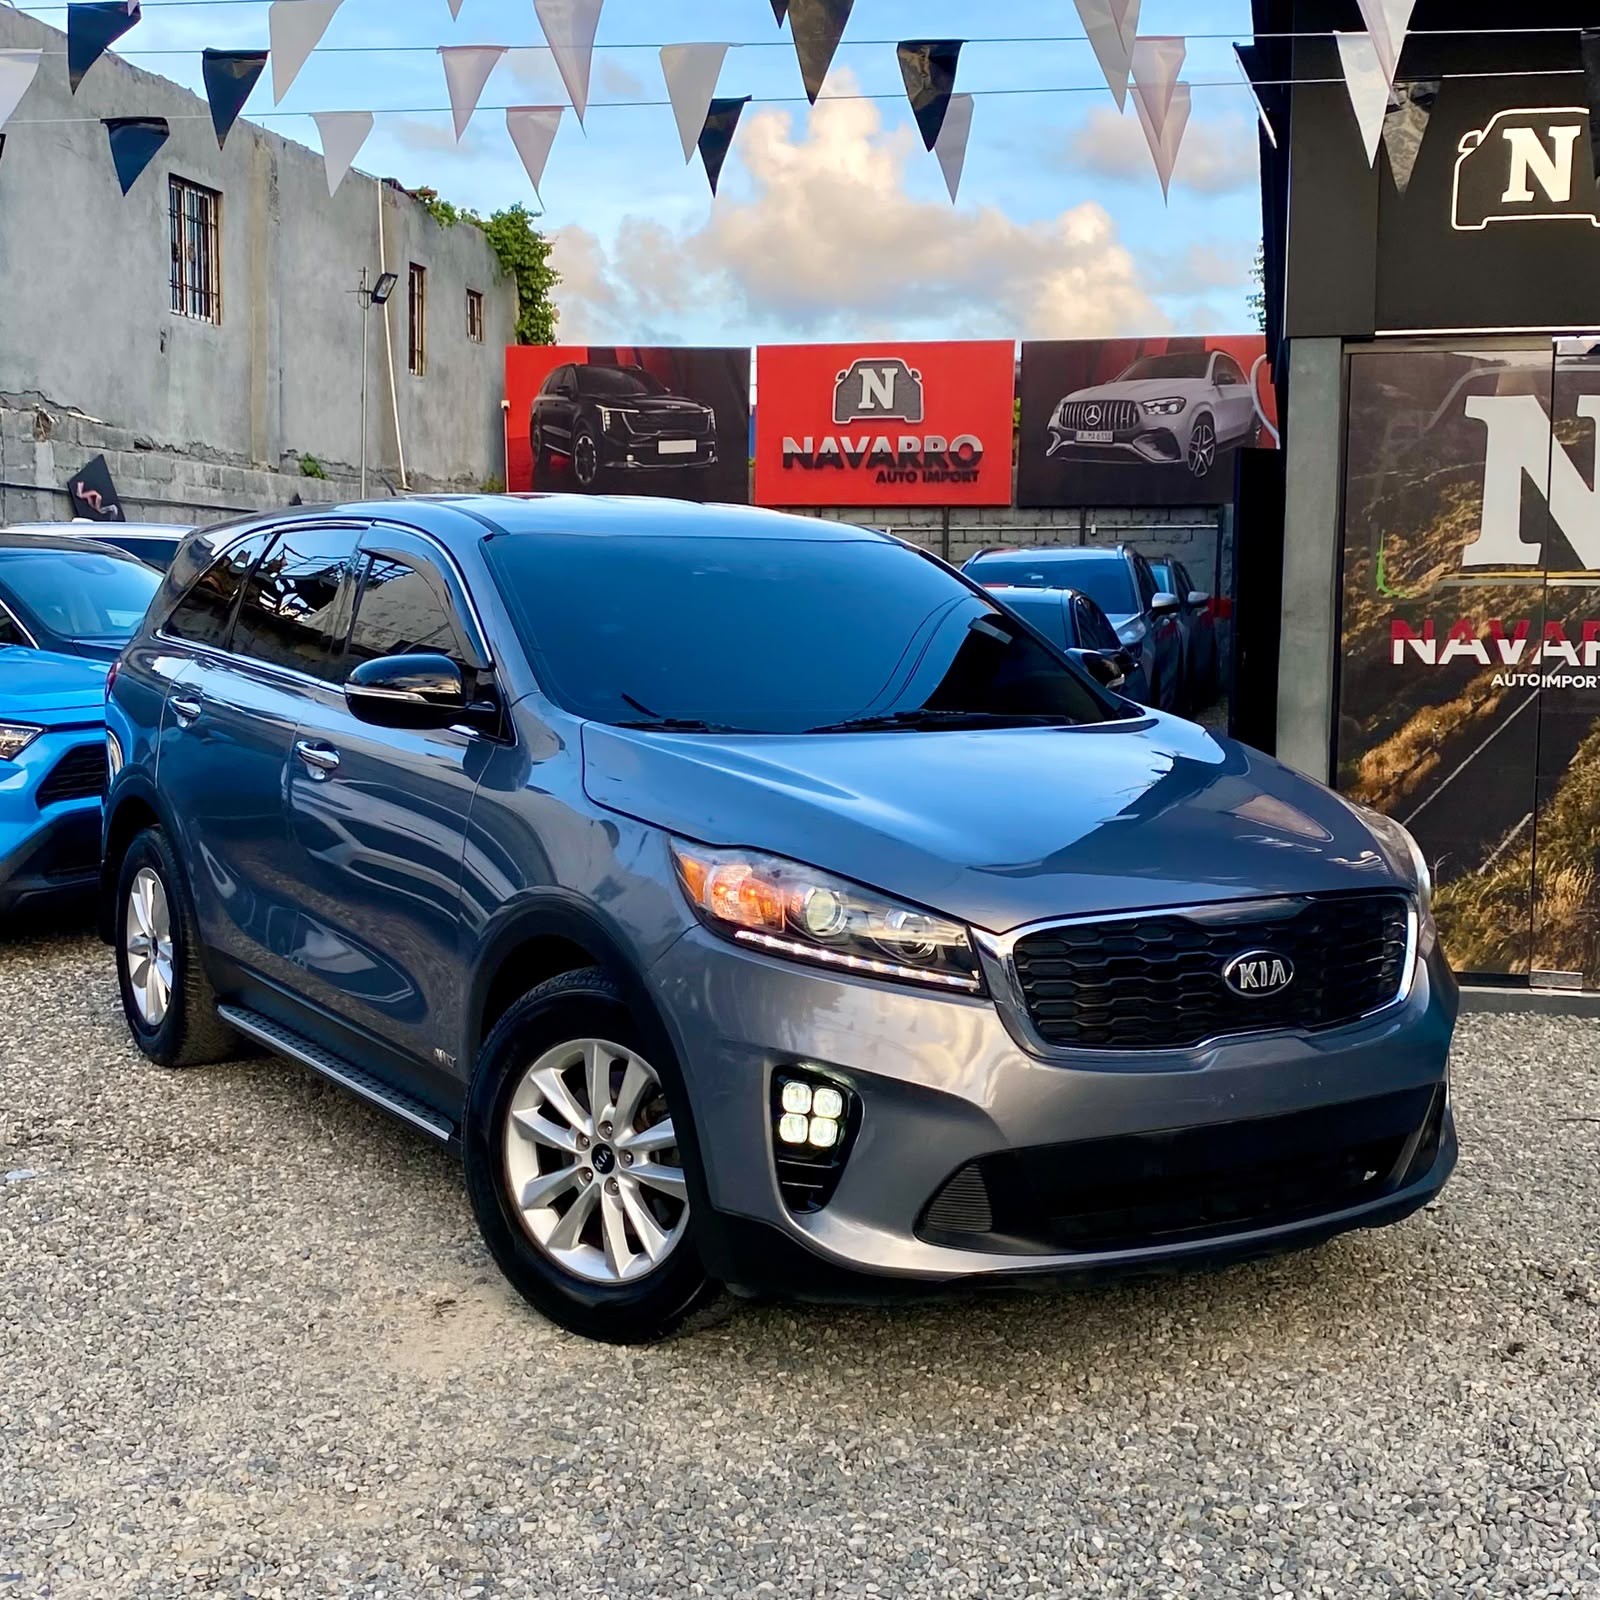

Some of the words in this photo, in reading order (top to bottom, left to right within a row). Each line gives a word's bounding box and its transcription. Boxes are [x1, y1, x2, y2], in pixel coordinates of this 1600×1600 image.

[1501, 125, 1581, 202] N
[858, 367, 898, 410] N
[783, 435, 984, 469] NAVARRO
[875, 470, 918, 484] AUTO
[922, 469, 980, 484] IMPORT
[1462, 394, 1600, 570] N
[1239, 959, 1286, 989] KIA
[594, 1150, 611, 1171] KIA
